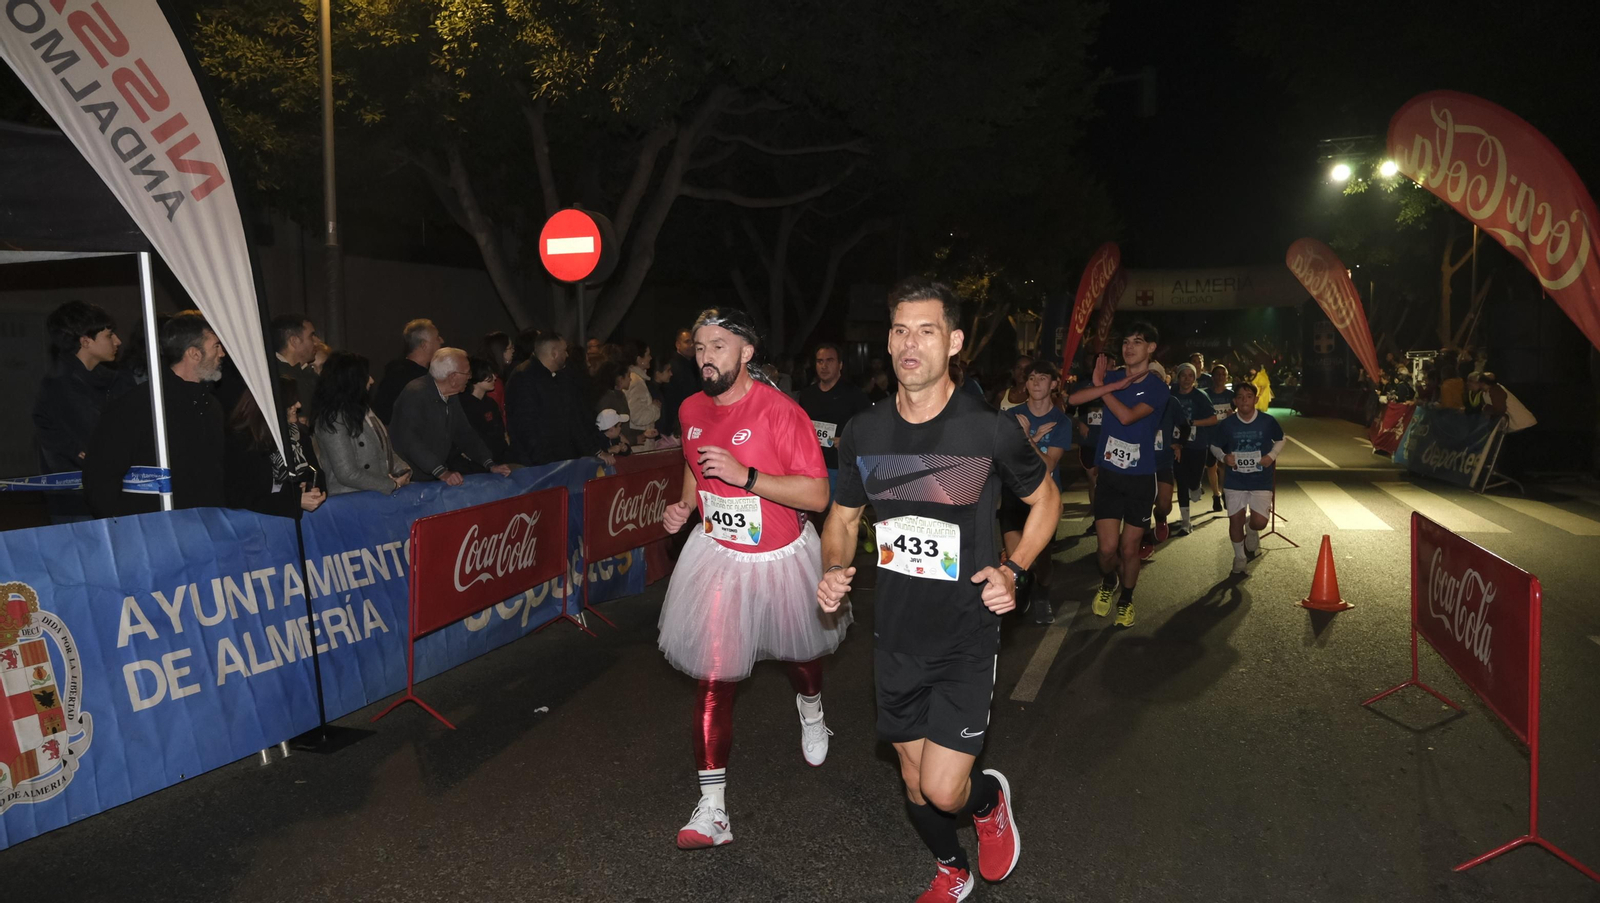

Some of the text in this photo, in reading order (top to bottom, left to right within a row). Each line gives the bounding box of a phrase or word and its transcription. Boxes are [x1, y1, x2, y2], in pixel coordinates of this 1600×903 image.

[1171, 296, 1213, 305] CIUDAD
[1112, 448, 1131, 461] 431
[608, 477, 669, 537] Coca-Cola
[712, 510, 746, 528] 403
[454, 508, 542, 592] Coca-Cola
[893, 534, 939, 557] 433
[1428, 547, 1498, 668] Coca-Cola
[22, 626, 40, 637] DECI
[122, 594, 389, 712] DE ALMERÍA
[41, 616, 78, 721] DIDA POR LA LIBERTAD
[7, 775, 67, 801] DE ALMERIA
